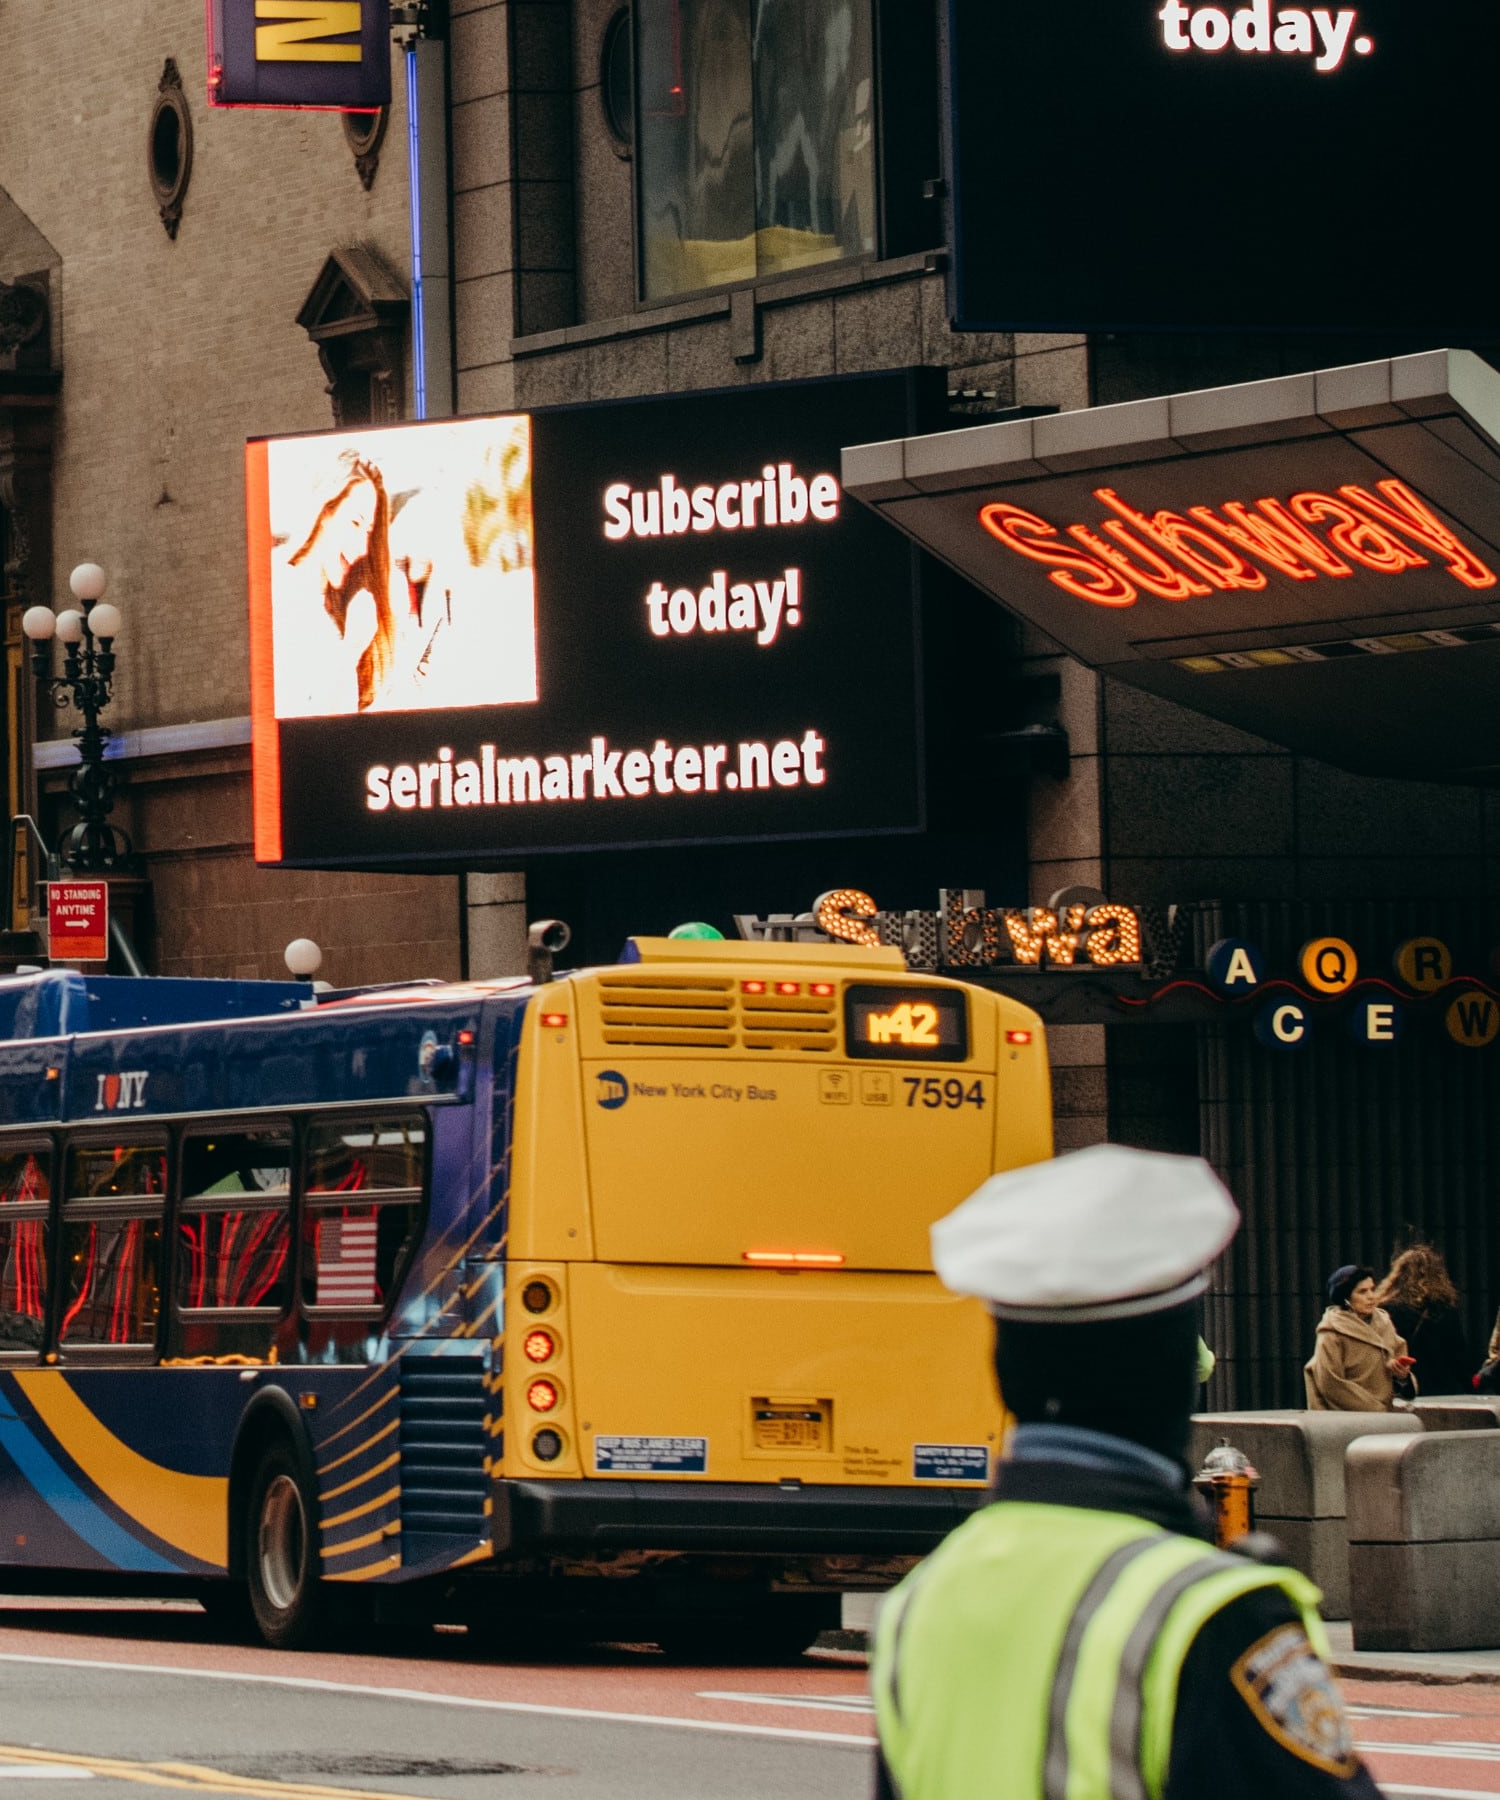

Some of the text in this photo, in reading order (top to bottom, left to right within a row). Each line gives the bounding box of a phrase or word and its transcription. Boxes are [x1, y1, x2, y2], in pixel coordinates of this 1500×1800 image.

[602, 462, 840, 544] Subscribe
[978, 478, 1498, 608] Subway
[646, 568, 803, 648] today!
[365, 726, 827, 811] serialmarketer.net
[51, 889, 101, 900] NO STANDING
[56, 904, 96, 915] ANYTIME
[1224, 948, 1257, 984] A
[1315, 946, 1347, 985] Q
[1414, 946, 1443, 982] R
[867, 1004, 939, 1045] M42
[1272, 1005, 1304, 1042] C
[1366, 1004, 1395, 1040] E
[1457, 1001, 1492, 1038] W
[634, 1082, 777, 1101] New York City Bus
[903, 1077, 986, 1109] 7594
